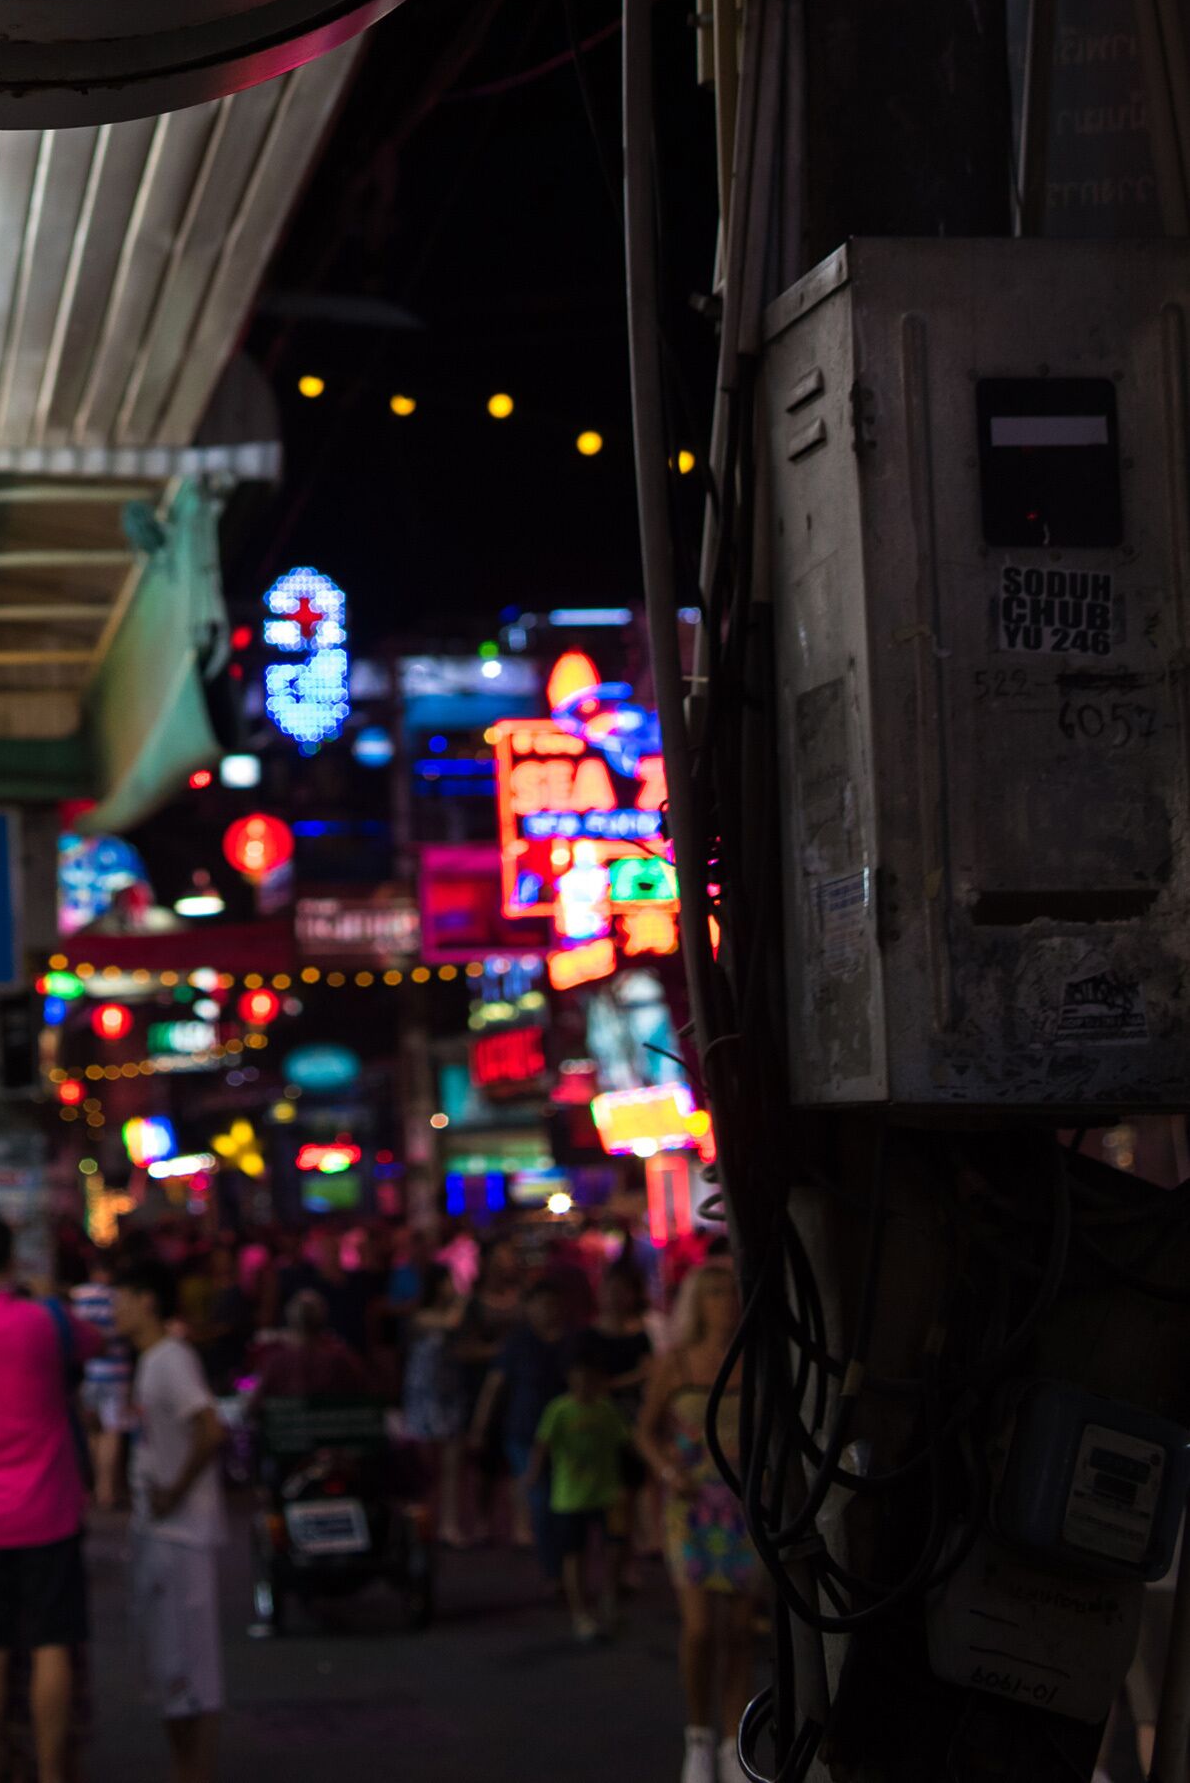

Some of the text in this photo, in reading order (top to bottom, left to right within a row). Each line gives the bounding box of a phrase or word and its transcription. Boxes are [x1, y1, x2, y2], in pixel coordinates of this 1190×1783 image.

[1002, 567, 1111, 602] SODUH
[1002, 596, 1110, 630] CHUB
[1003, 623, 1111, 655] YU 246
